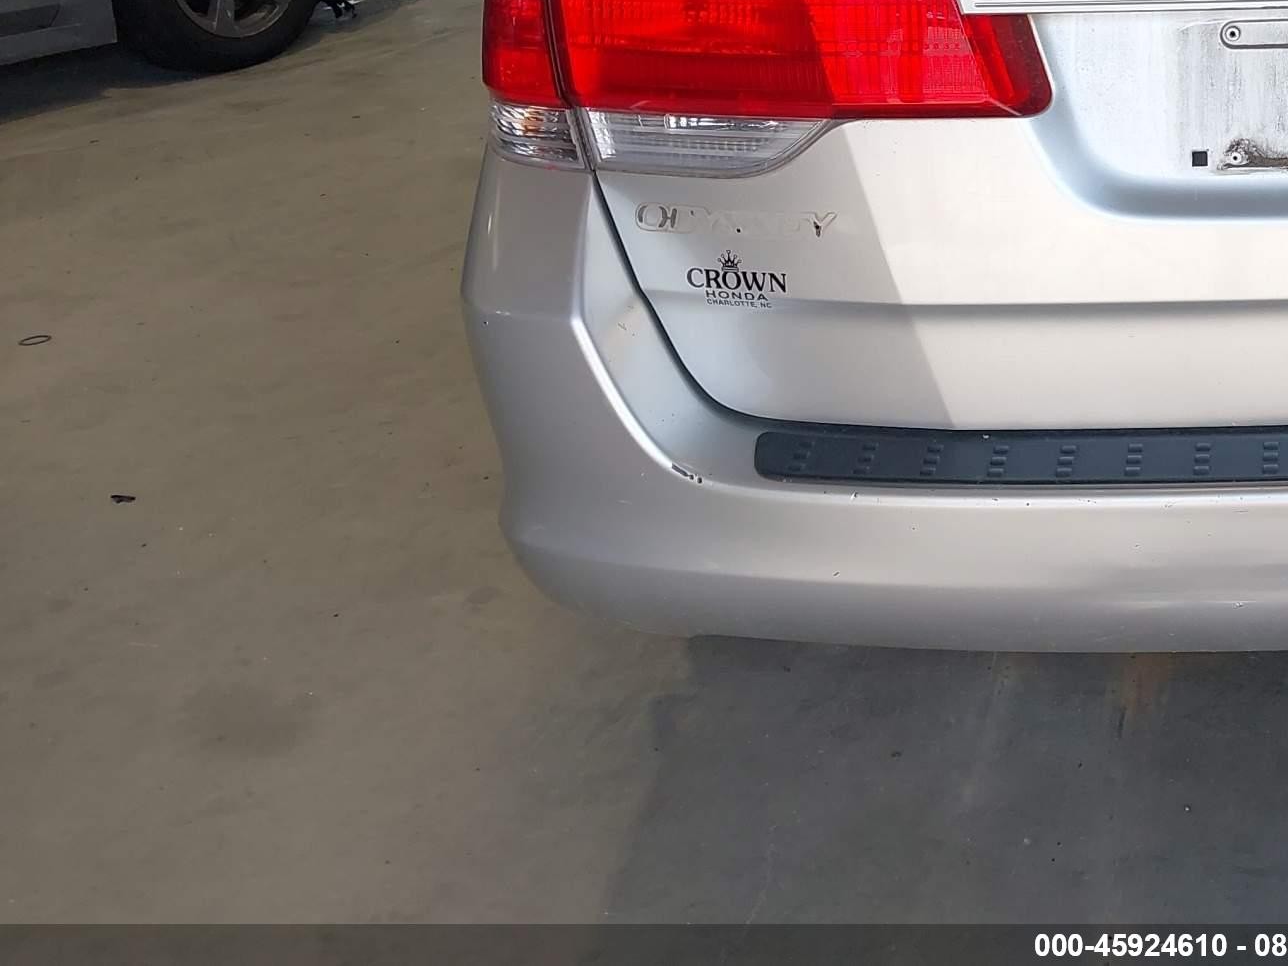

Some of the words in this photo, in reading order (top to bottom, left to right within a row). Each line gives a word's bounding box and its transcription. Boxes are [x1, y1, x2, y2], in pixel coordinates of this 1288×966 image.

[686, 267, 787, 293] CROWN
[705, 289, 769, 301] HONDA
[760, 301, 772, 309] NC
